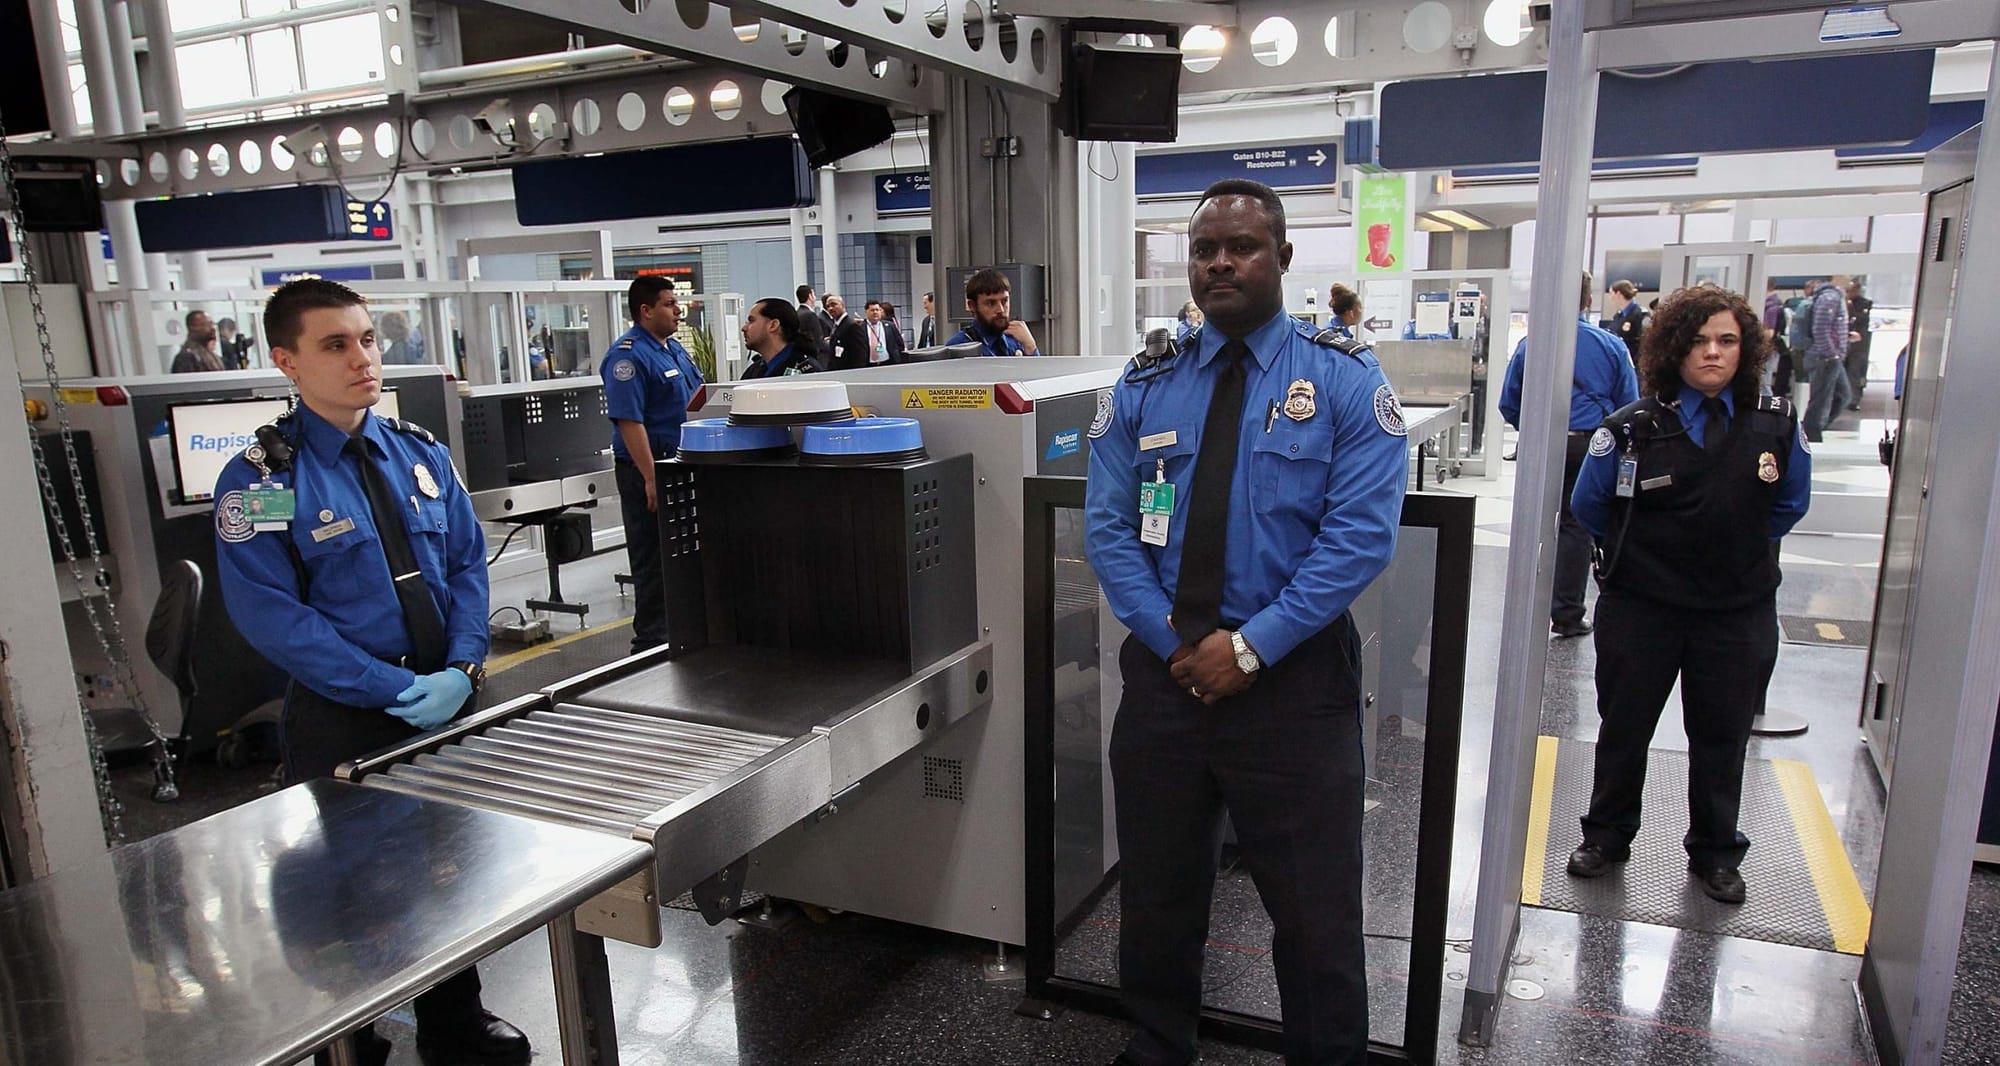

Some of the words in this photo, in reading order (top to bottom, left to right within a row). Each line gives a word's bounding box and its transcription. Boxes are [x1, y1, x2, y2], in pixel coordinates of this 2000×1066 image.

[1246, 160, 1286, 169] Restrooms
[1770, 396, 1782, 410] TSA
[190, 432, 256, 451] Rapisc
